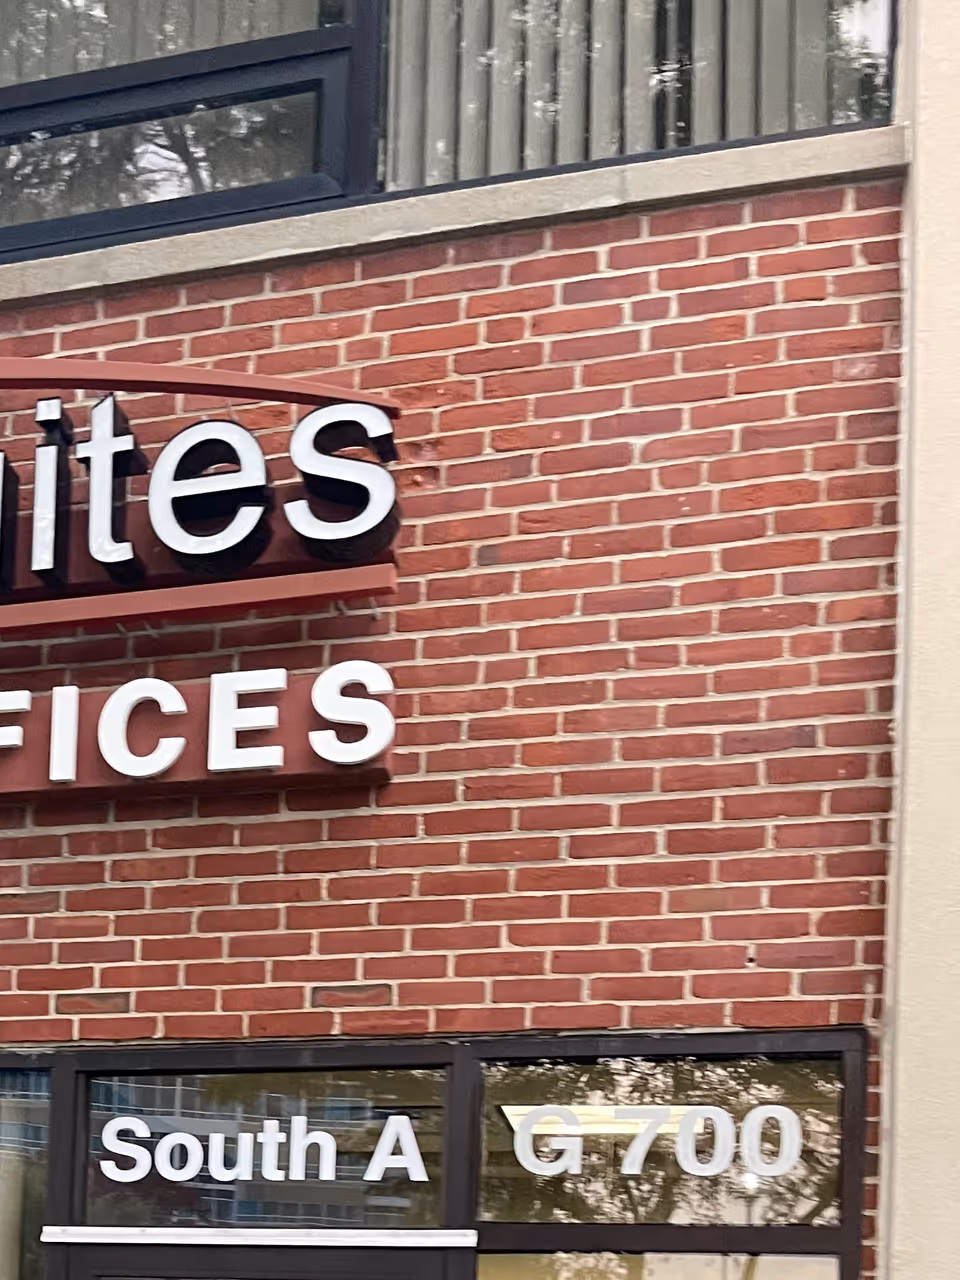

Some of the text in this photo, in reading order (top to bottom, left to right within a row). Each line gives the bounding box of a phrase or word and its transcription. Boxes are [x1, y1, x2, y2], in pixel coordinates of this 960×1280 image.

[99, 1114, 429, 1182] South A
[513, 1103, 803, 1178] G 700
